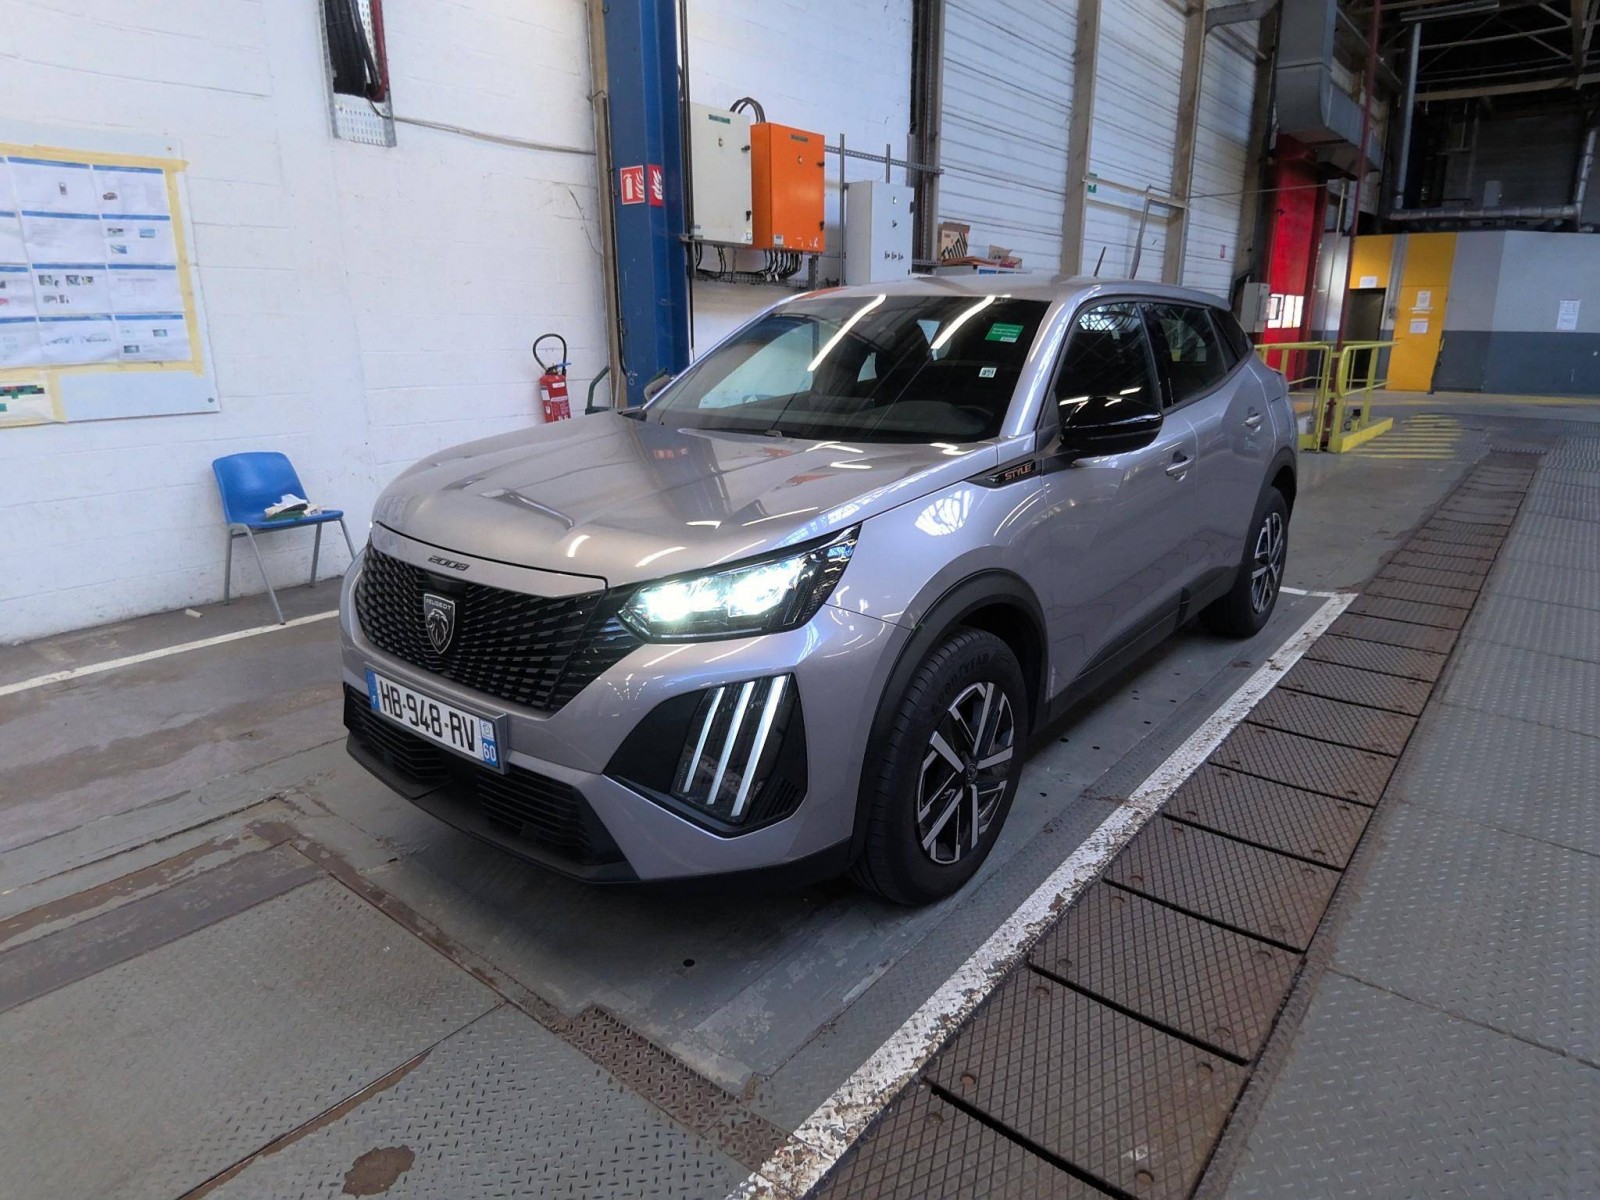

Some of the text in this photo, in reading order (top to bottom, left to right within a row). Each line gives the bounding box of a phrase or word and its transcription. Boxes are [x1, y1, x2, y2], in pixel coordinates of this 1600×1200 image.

[1004, 463, 1032, 480] STYLE
[428, 555, 470, 571] 2008
[426, 598, 452, 610] PEUGEOT
[482, 742, 497, 761] 60
